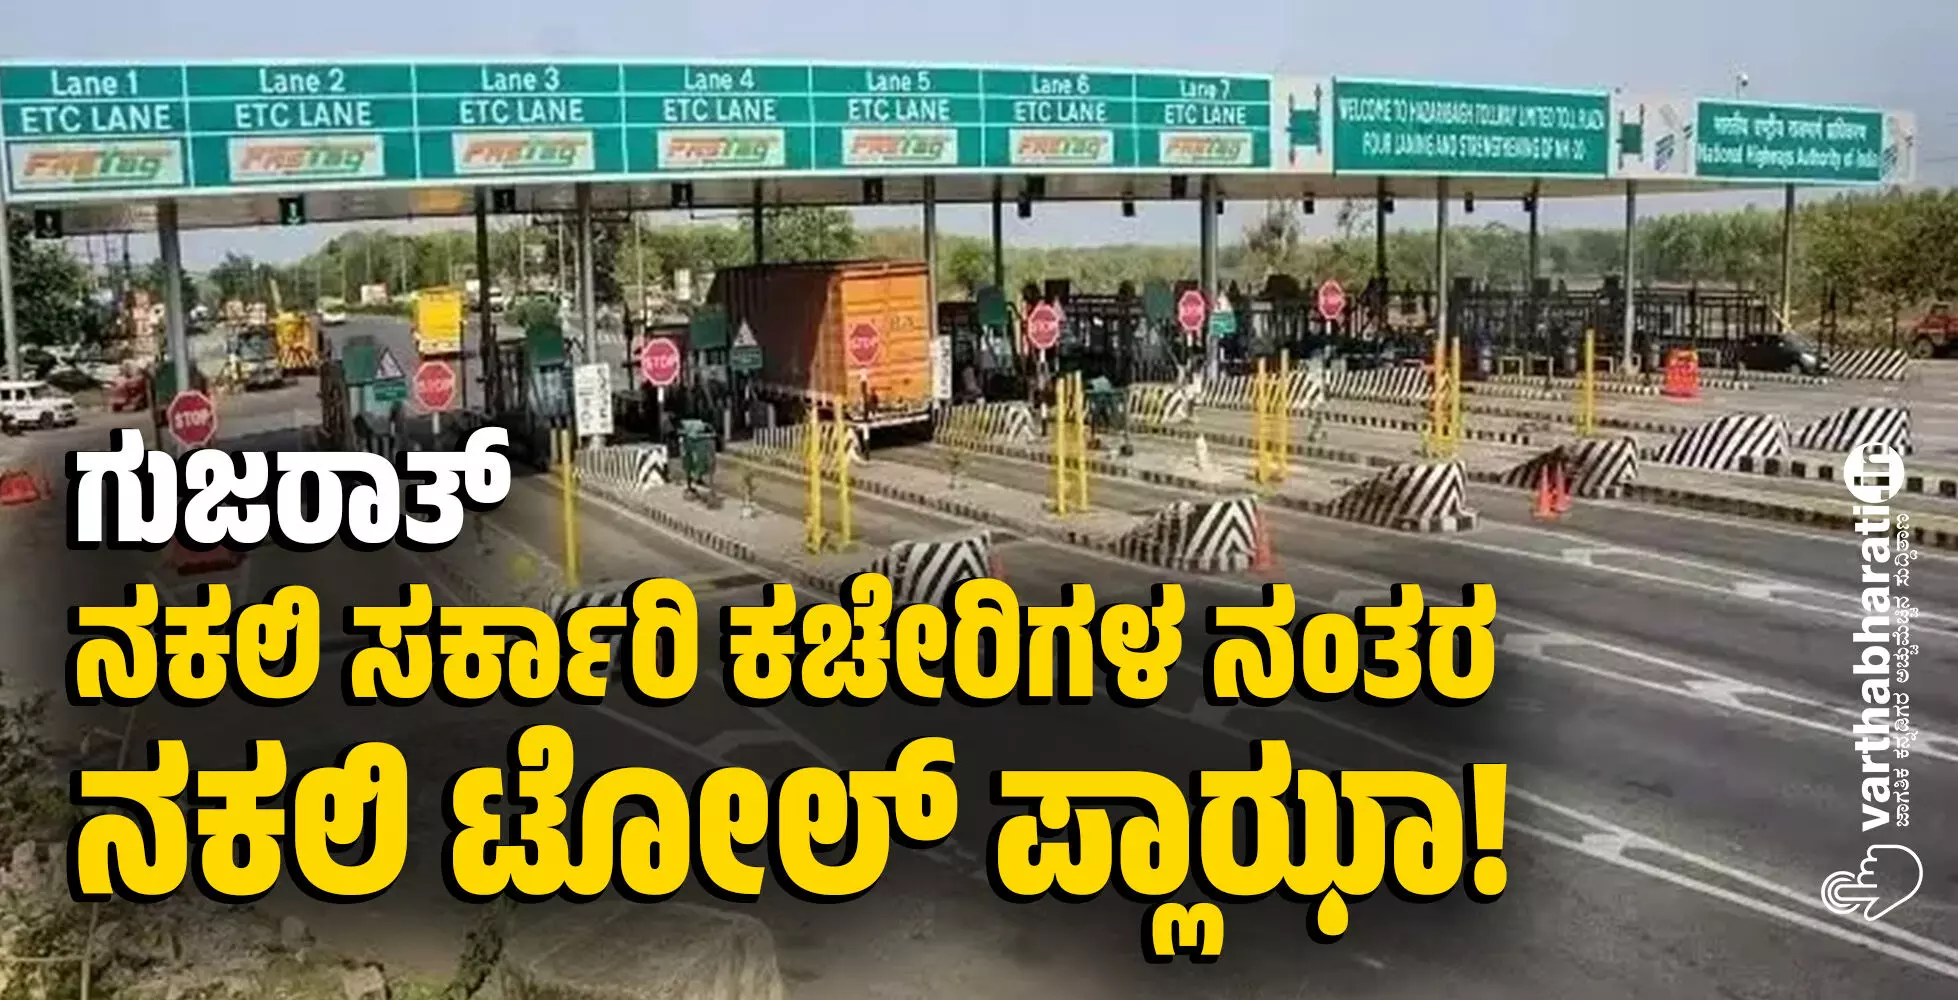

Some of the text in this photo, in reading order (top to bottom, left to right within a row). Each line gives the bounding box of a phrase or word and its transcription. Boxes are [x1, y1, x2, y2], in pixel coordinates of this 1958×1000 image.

[52, 69, 138, 96] Lane 1
[259, 67, 346, 93] Lane 2
[481, 65, 560, 91] Lane 3
[684, 65, 755, 90] Lane 4
[866, 69, 930, 91] Lane 5
[1031, 73, 1090, 94] Lane 6
[1220, 79, 1230, 100] 7
[20, 104, 172, 133] ETC LANE
[235, 101, 374, 128] ETC LANE
[460, 98, 584, 124] ETC LANE
[663, 98, 776, 121] ETC LANE
[848, 98, 950, 121] ETC LANE
[1014, 101, 1107, 122] ETC LANE
[1164, 104, 1247, 124] ETC LANE
[1338, 97, 1391, 122] WELCOME
[1393, 98, 1407, 122] TO
[1697, 141, 1743, 164] National
[1746, 143, 1794, 170] Highways
[1797, 147, 1841, 171] Authority
[1844, 147, 1855, 166] of
[174, 408, 212, 430] STOP
